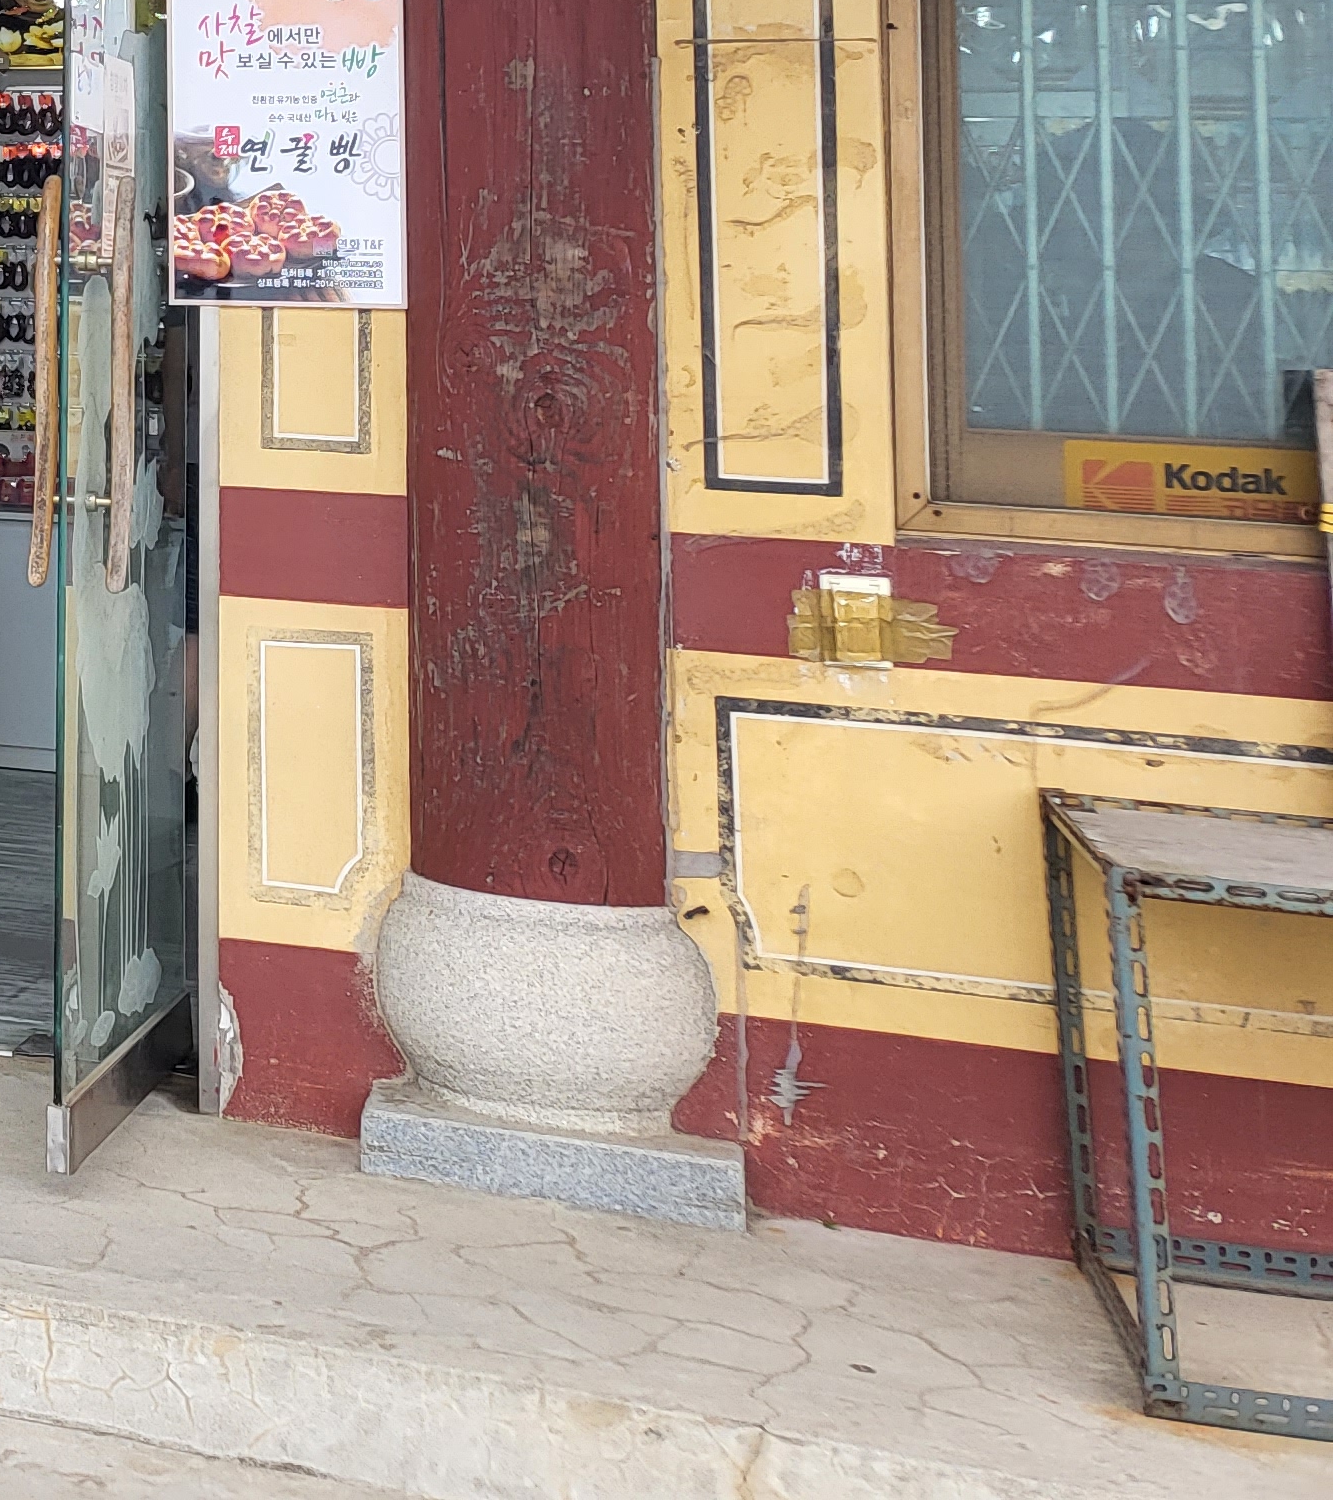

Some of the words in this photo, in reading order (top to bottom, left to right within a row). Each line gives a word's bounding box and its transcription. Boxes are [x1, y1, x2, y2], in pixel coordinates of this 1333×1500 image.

[300, 52, 337, 69] 있는
[341, 44, 386, 79] 빵
[218, 127, 237, 156] 수제
[337, 238, 360, 251] 연화
[362, 238, 384, 251] T&F
[1163, 462, 1288, 496] Kodak
